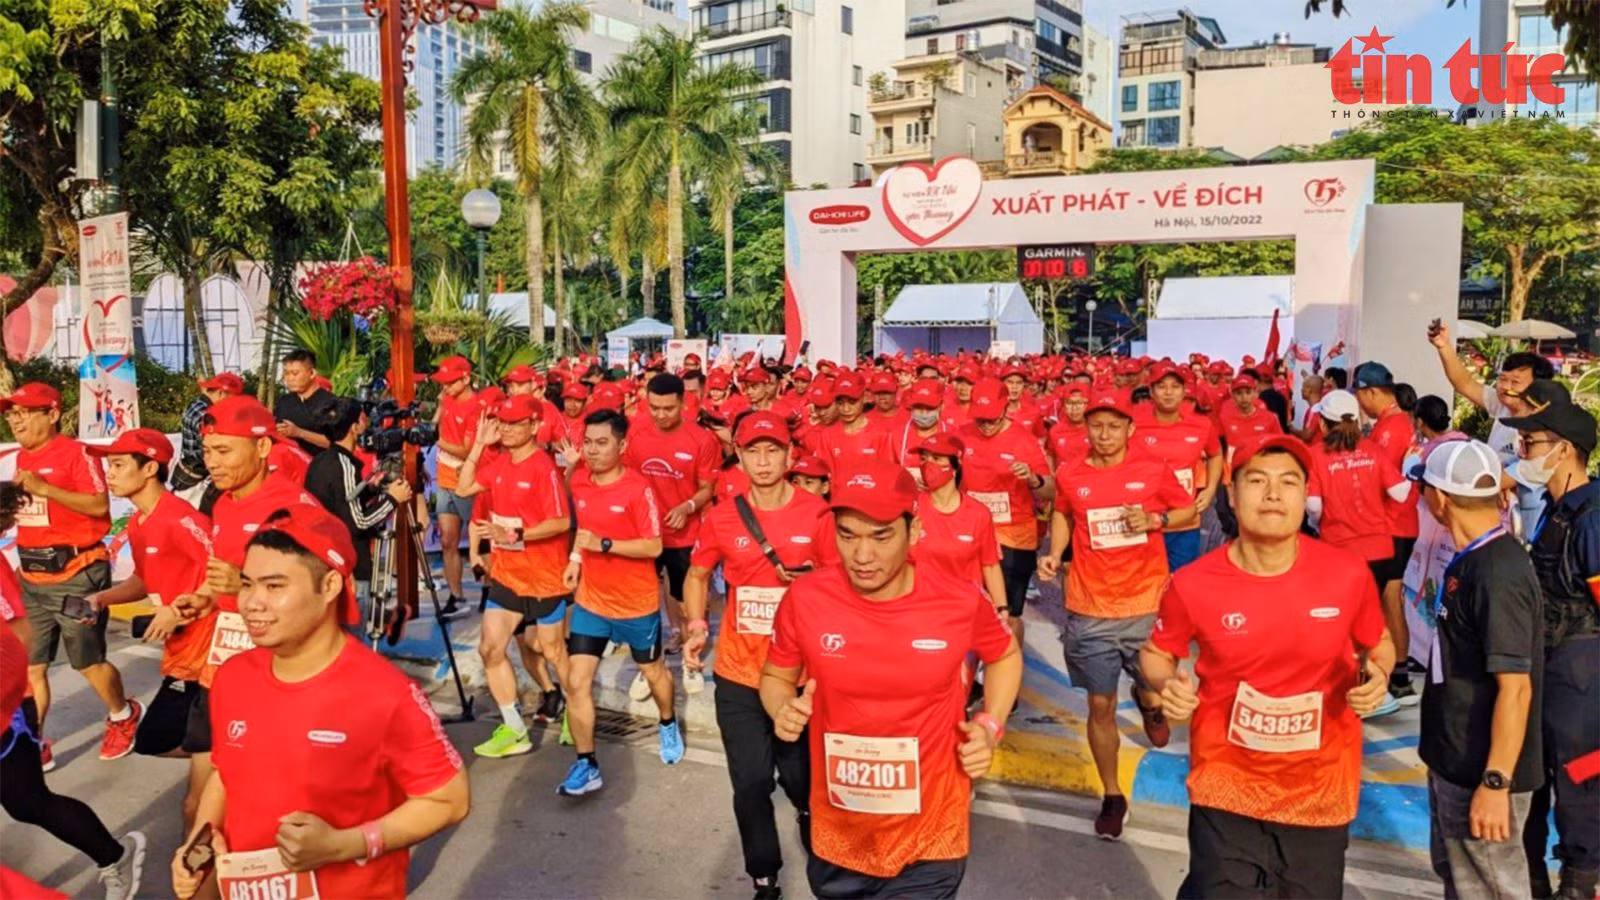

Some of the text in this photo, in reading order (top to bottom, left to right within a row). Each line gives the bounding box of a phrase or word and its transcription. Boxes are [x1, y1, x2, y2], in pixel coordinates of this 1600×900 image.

[992, 188, 1056, 216] XUẤT
[1062, 187, 1131, 213] PHÁT
[1153, 181, 1187, 209] VỀ
[1194, 181, 1263, 207] ĐÍCH
[1154, 215, 1263, 229] Hà Nội, 15/10/2022
[1024, 246, 1082, 259] GARMIN
[1238, 705, 1314, 735] 543832
[835, 758, 907, 789] 482101
[229, 870, 298, 900] 481167
